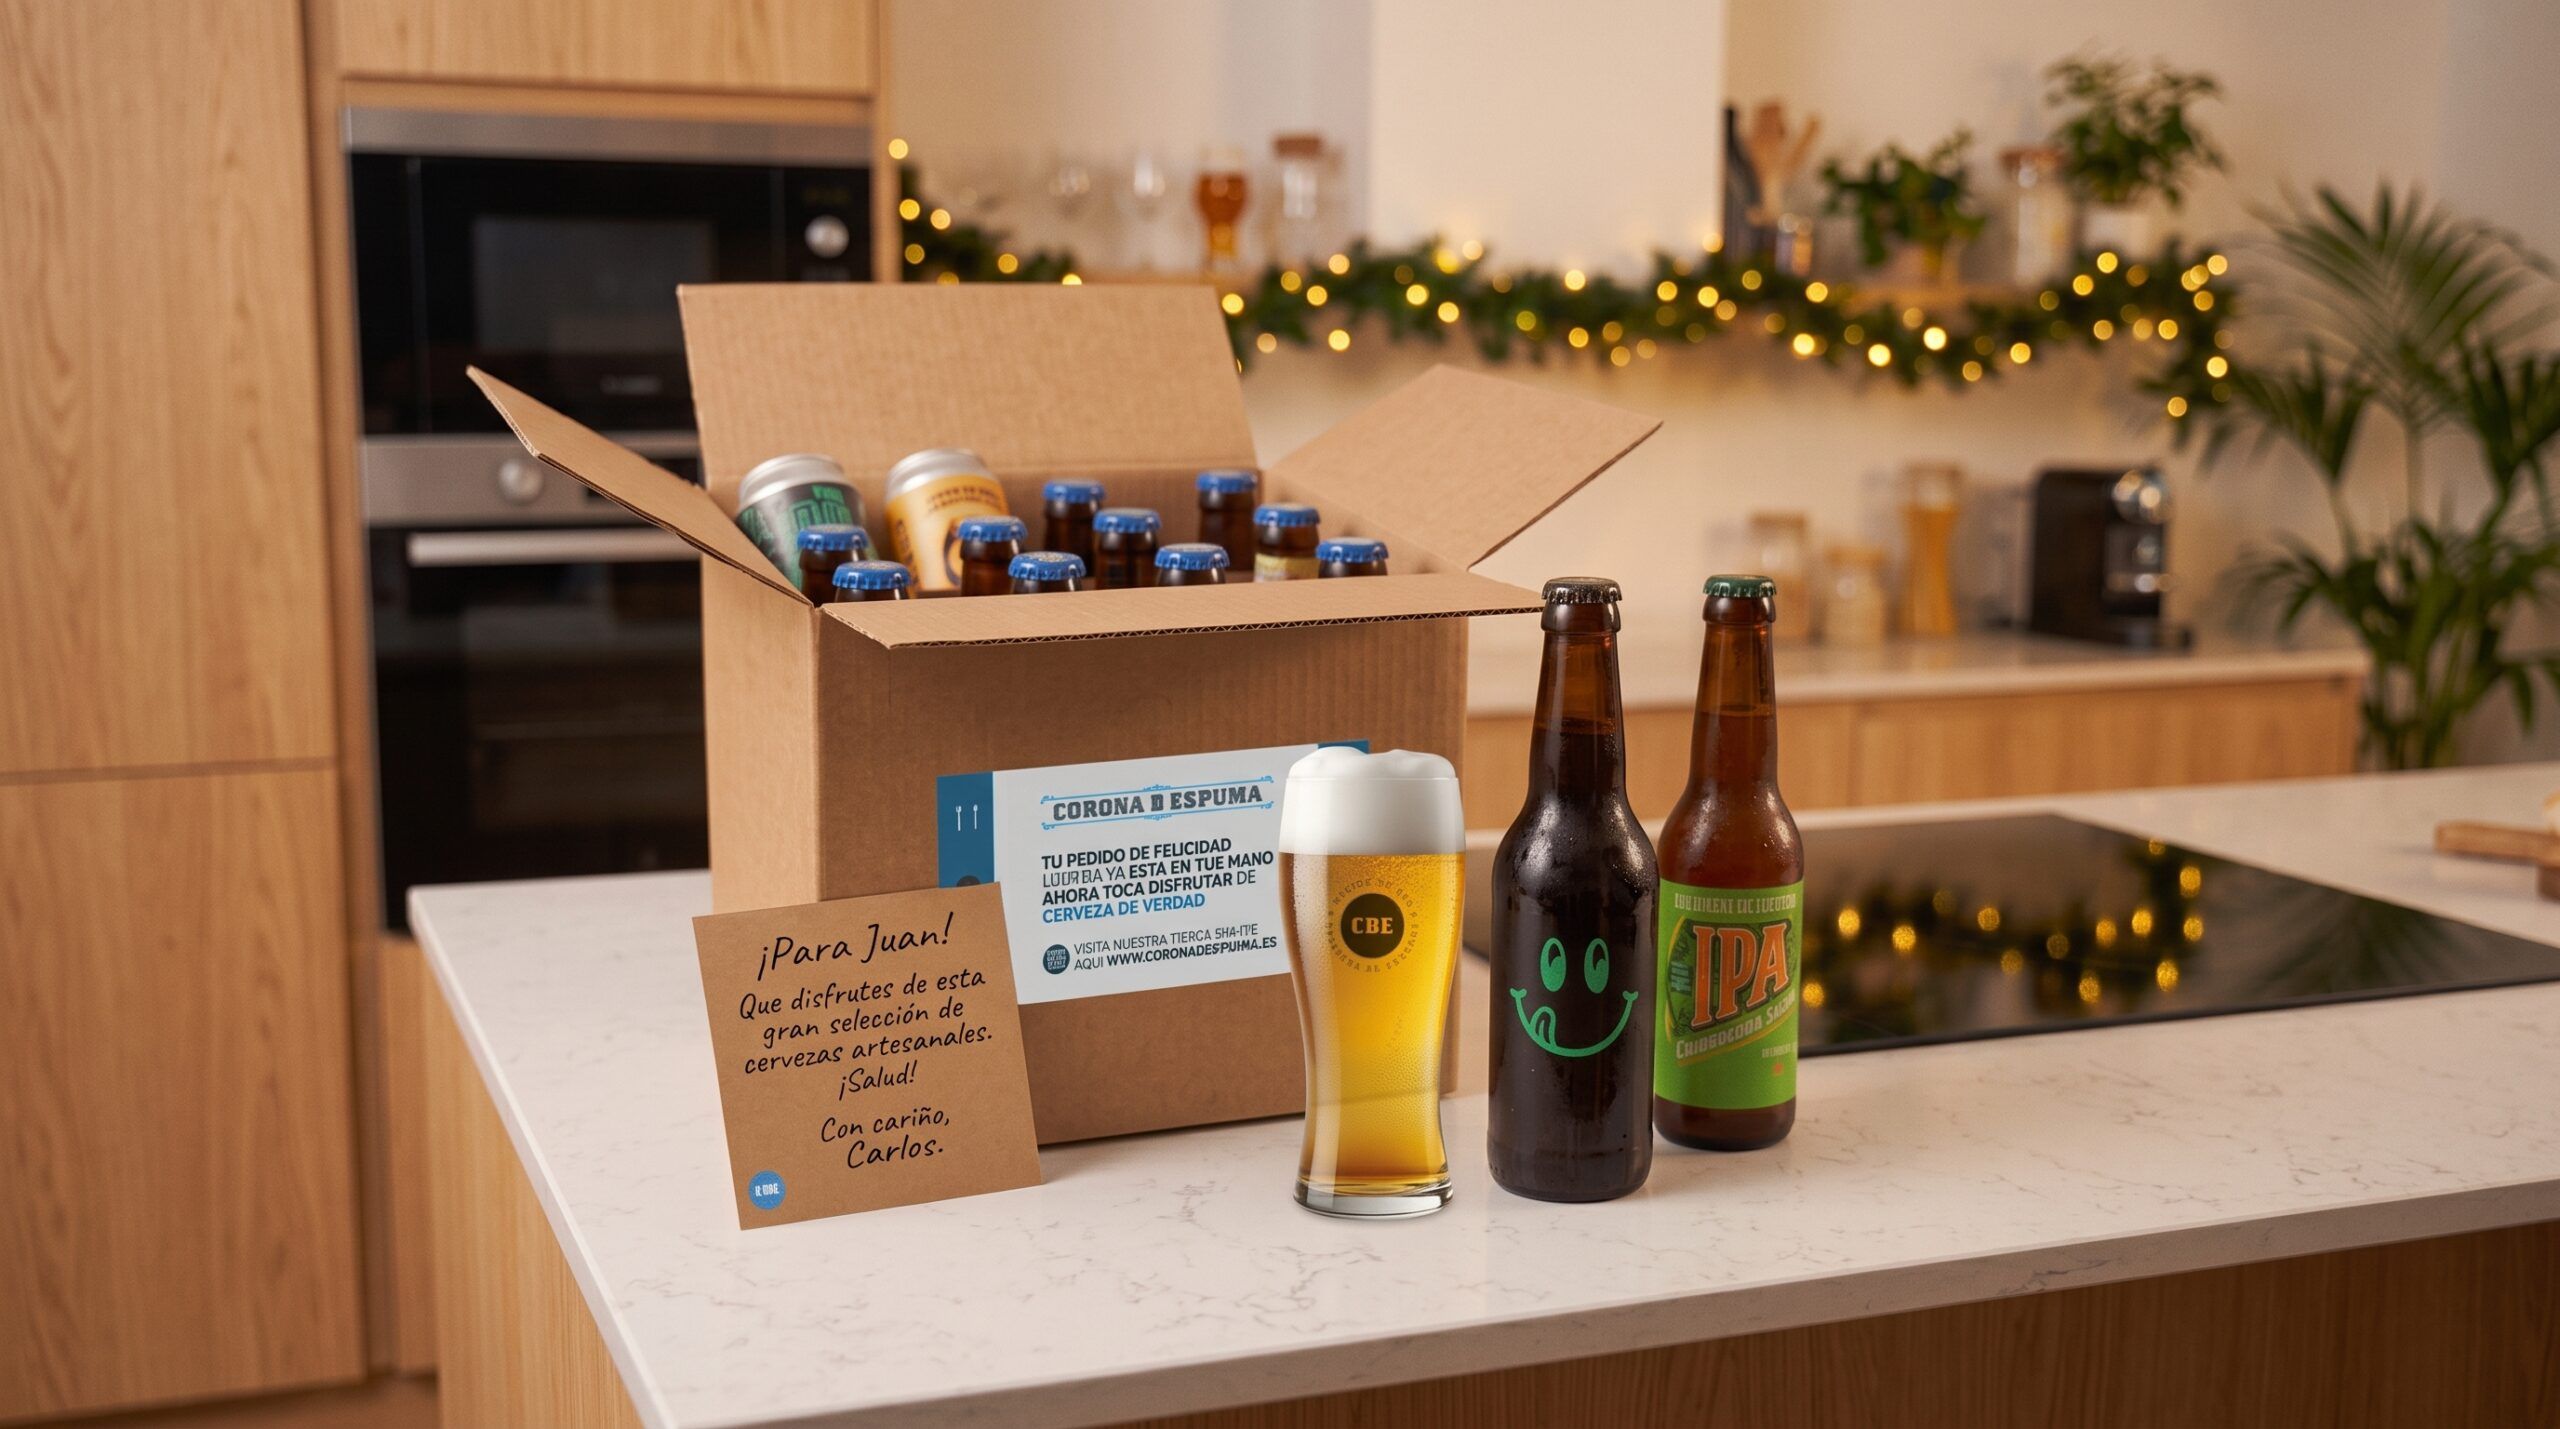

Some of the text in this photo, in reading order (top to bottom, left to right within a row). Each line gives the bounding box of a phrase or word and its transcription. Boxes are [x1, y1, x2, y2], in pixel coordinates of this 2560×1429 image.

[1053, 796, 1145, 821] CORONA
[1170, 785, 1263, 810] ESPUMA
[1041, 838, 1232, 870] TU PEDIDO DE FELICIDAD
[1106, 866, 1126, 881] YA
[1129, 861, 1167, 879] ESTA
[1171, 859, 1191, 875] EN
[1195, 856, 1225, 872] TUE
[1228, 850, 1274, 869] MANO
[1042, 869, 1256, 906] AHORA TOCA DISFRUTAR DE
[1042, 893, 1206, 923] CERVEZA DE VERDAD
[1351, 917, 1394, 935] CBE
[758, 911, 954, 982] ¡Para Juan!
[1074, 941, 1111, 955] VISITA
[1114, 934, 1168, 951] NUESTRA
[1074, 956, 1104, 971] AQUI
[1691, 922, 1790, 1028] IPA
[740, 968, 986, 1020] Que disfrutes de esta
[763, 996, 964, 1049] gran selección de
[744, 1022, 993, 1074] cervezas artesanales.
[839, 1060, 918, 1101] ¡Salud!
[821, 1107, 951, 1143] Con cariño,
[847, 1134, 944, 1169] Carlos.
